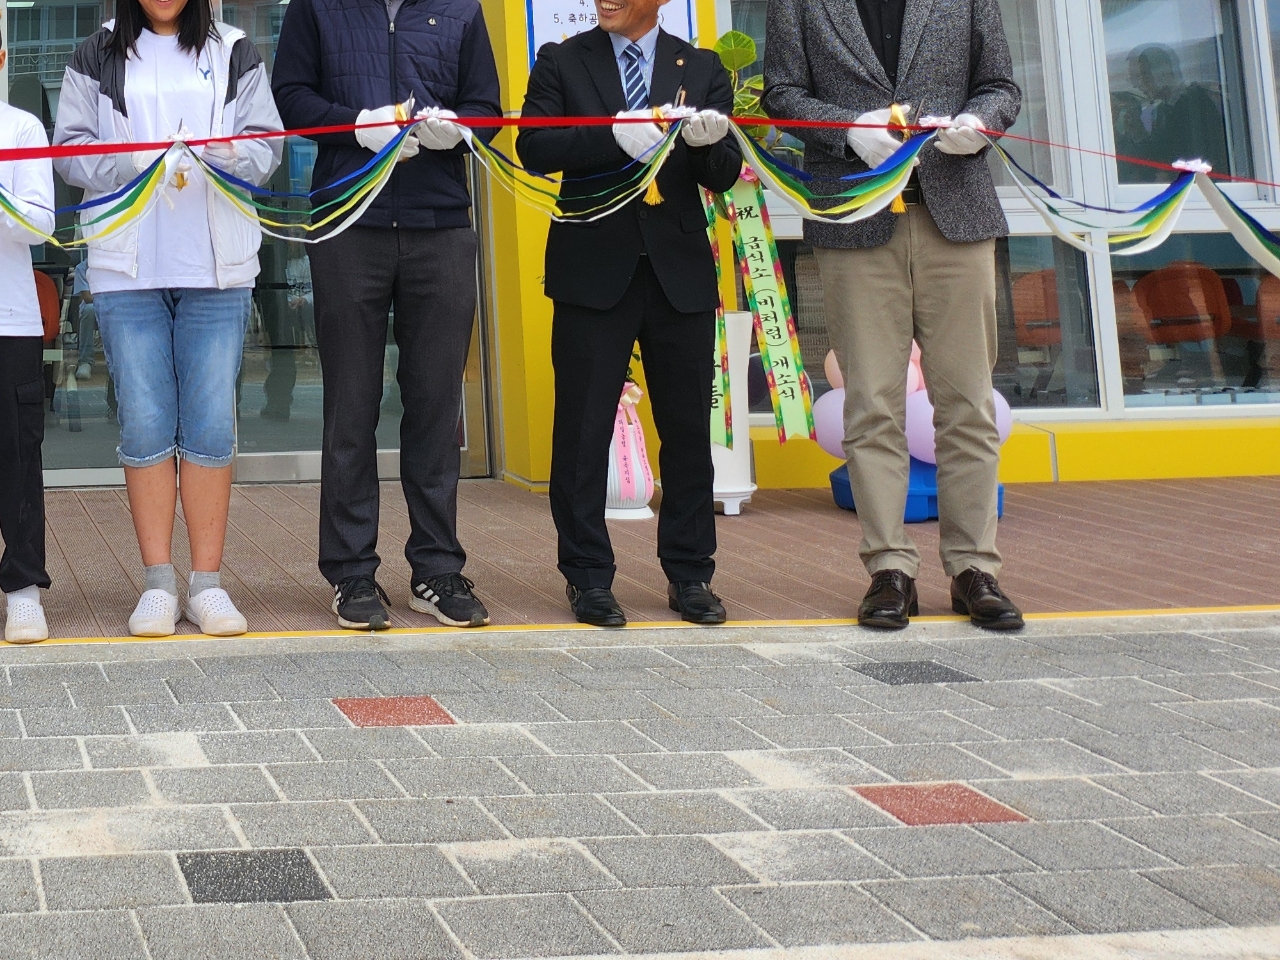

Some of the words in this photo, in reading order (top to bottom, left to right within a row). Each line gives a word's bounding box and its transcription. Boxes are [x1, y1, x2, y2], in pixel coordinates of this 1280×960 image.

[553, 13, 564, 25] 5.
[735, 205, 760, 221] 祝
[743, 236, 773, 280] 급식소
[753, 288, 788, 347] (비처럼)
[772, 356, 797, 401] 개소식
